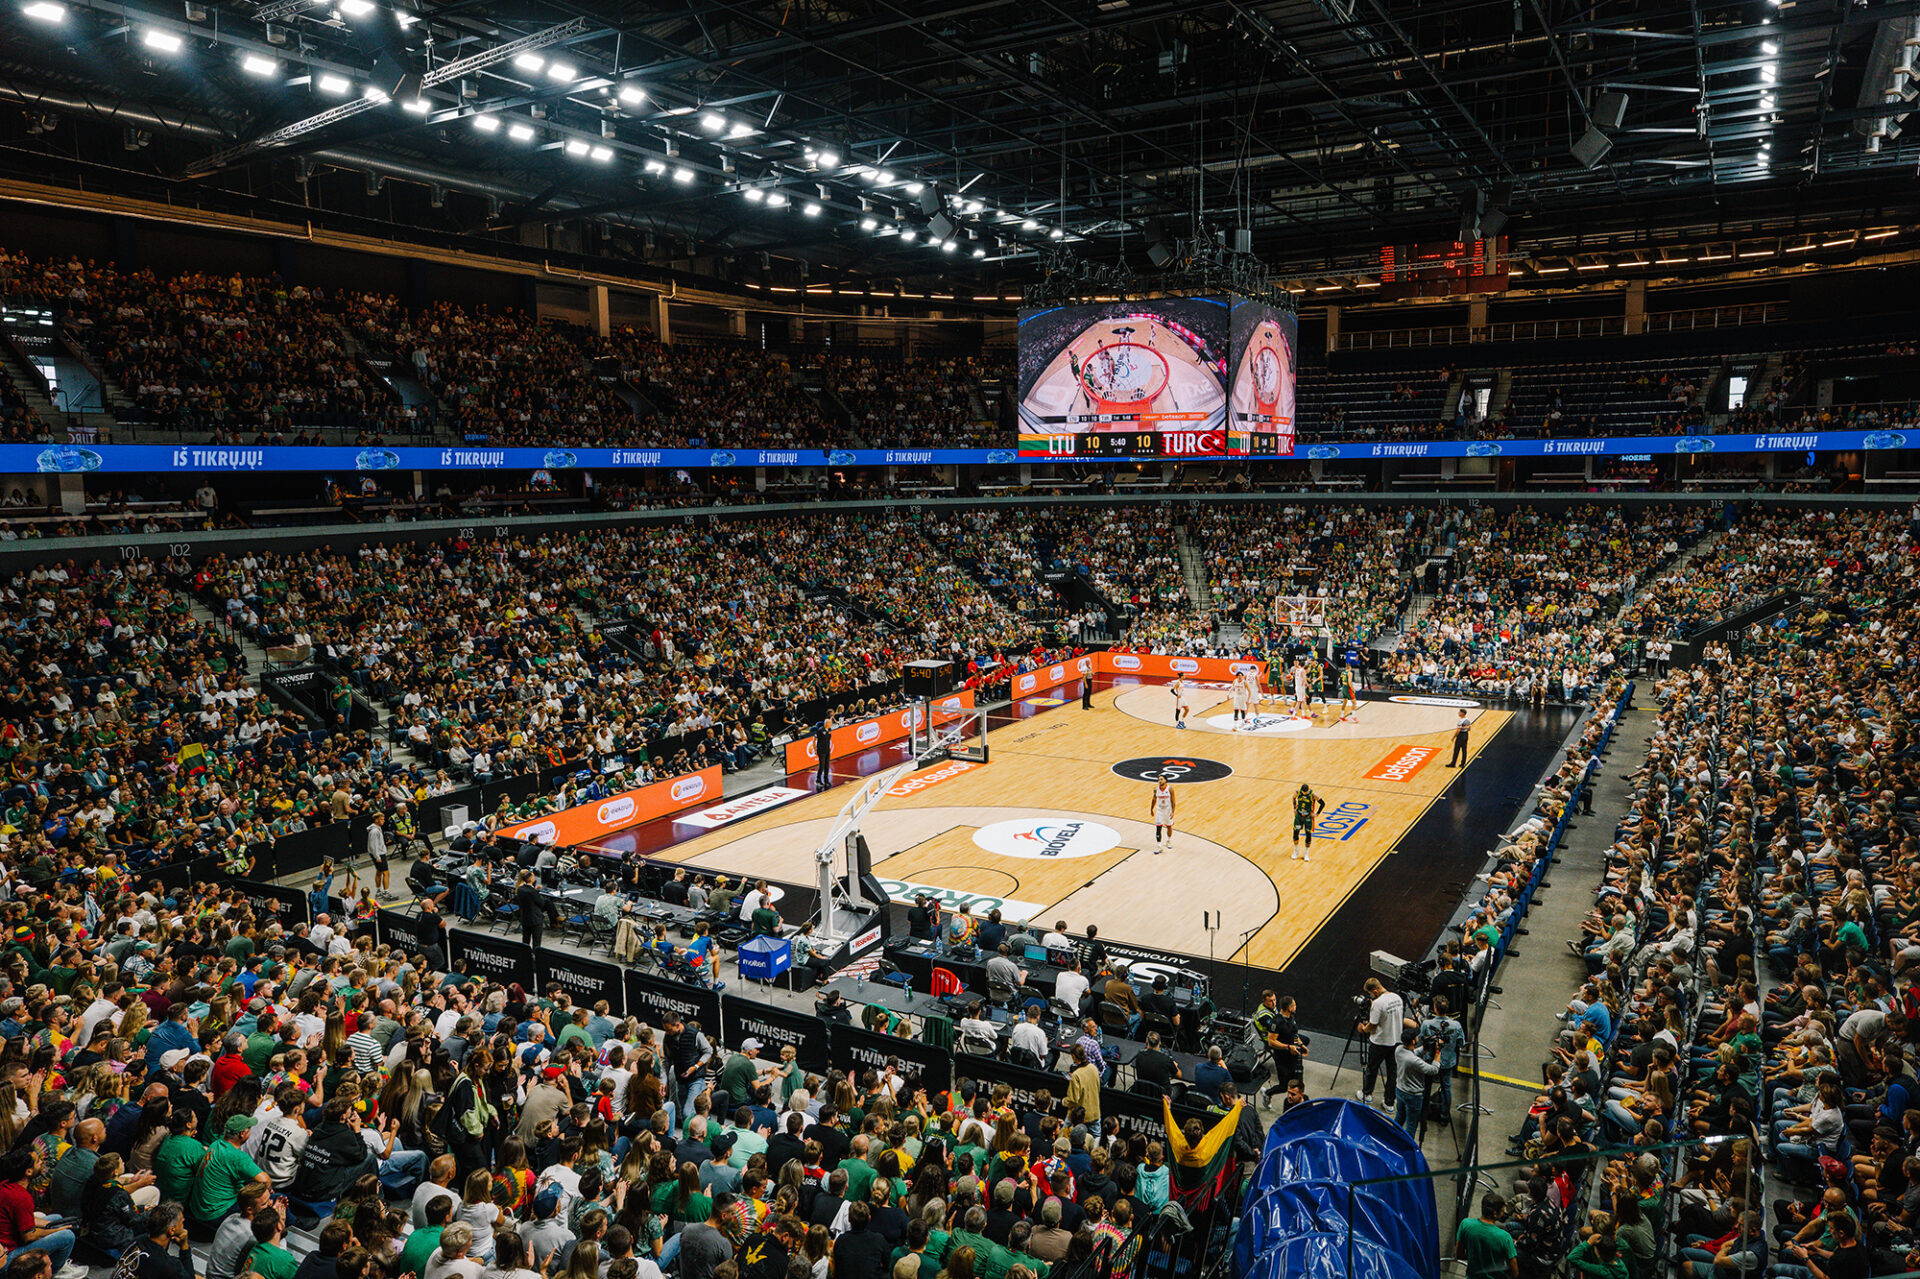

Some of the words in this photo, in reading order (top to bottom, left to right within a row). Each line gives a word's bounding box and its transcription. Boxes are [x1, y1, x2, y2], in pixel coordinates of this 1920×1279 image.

[1049, 435, 1075, 455] LTU
[1086, 436, 1099, 449] 10
[1110, 438, 1126, 447] 5:40
[1136, 435, 1151, 448] 10
[1163, 433, 1196, 454] TUR
[1372, 443, 1383, 456] IŠ
[1544, 440, 1555, 453] IŠ
[1755, 434, 1766, 449] IŠ
[173, 447, 188, 467] IŠ
[192, 450, 263, 470] TIKRŲJŲ!
[441, 449, 453, 466] IŠ
[459, 528, 474, 539] 103
[495, 526, 508, 537] 104
[120, 546, 141, 559] 101
[170, 544, 191, 556] 102
[1726, 630, 1740, 640] 113
[910, 667, 932, 679] 5:40
[1372, 747, 1433, 781] betsson
[725, 790, 791, 815] ANTĖJA
[1040, 822, 1085, 857] BIOVELA
[389, 928, 417, 945] TWINS
[463, 948, 516, 969] TWINSBET
[742, 958, 767, 968] molten
[549, 967, 605, 991] TWINSBET
[640, 991, 700, 1017] TWINSBET
[739, 1017, 806, 1046] TWINSBET
[851, 1047, 926, 1074] TWINBET
[259, 1128, 286, 1163] 82
